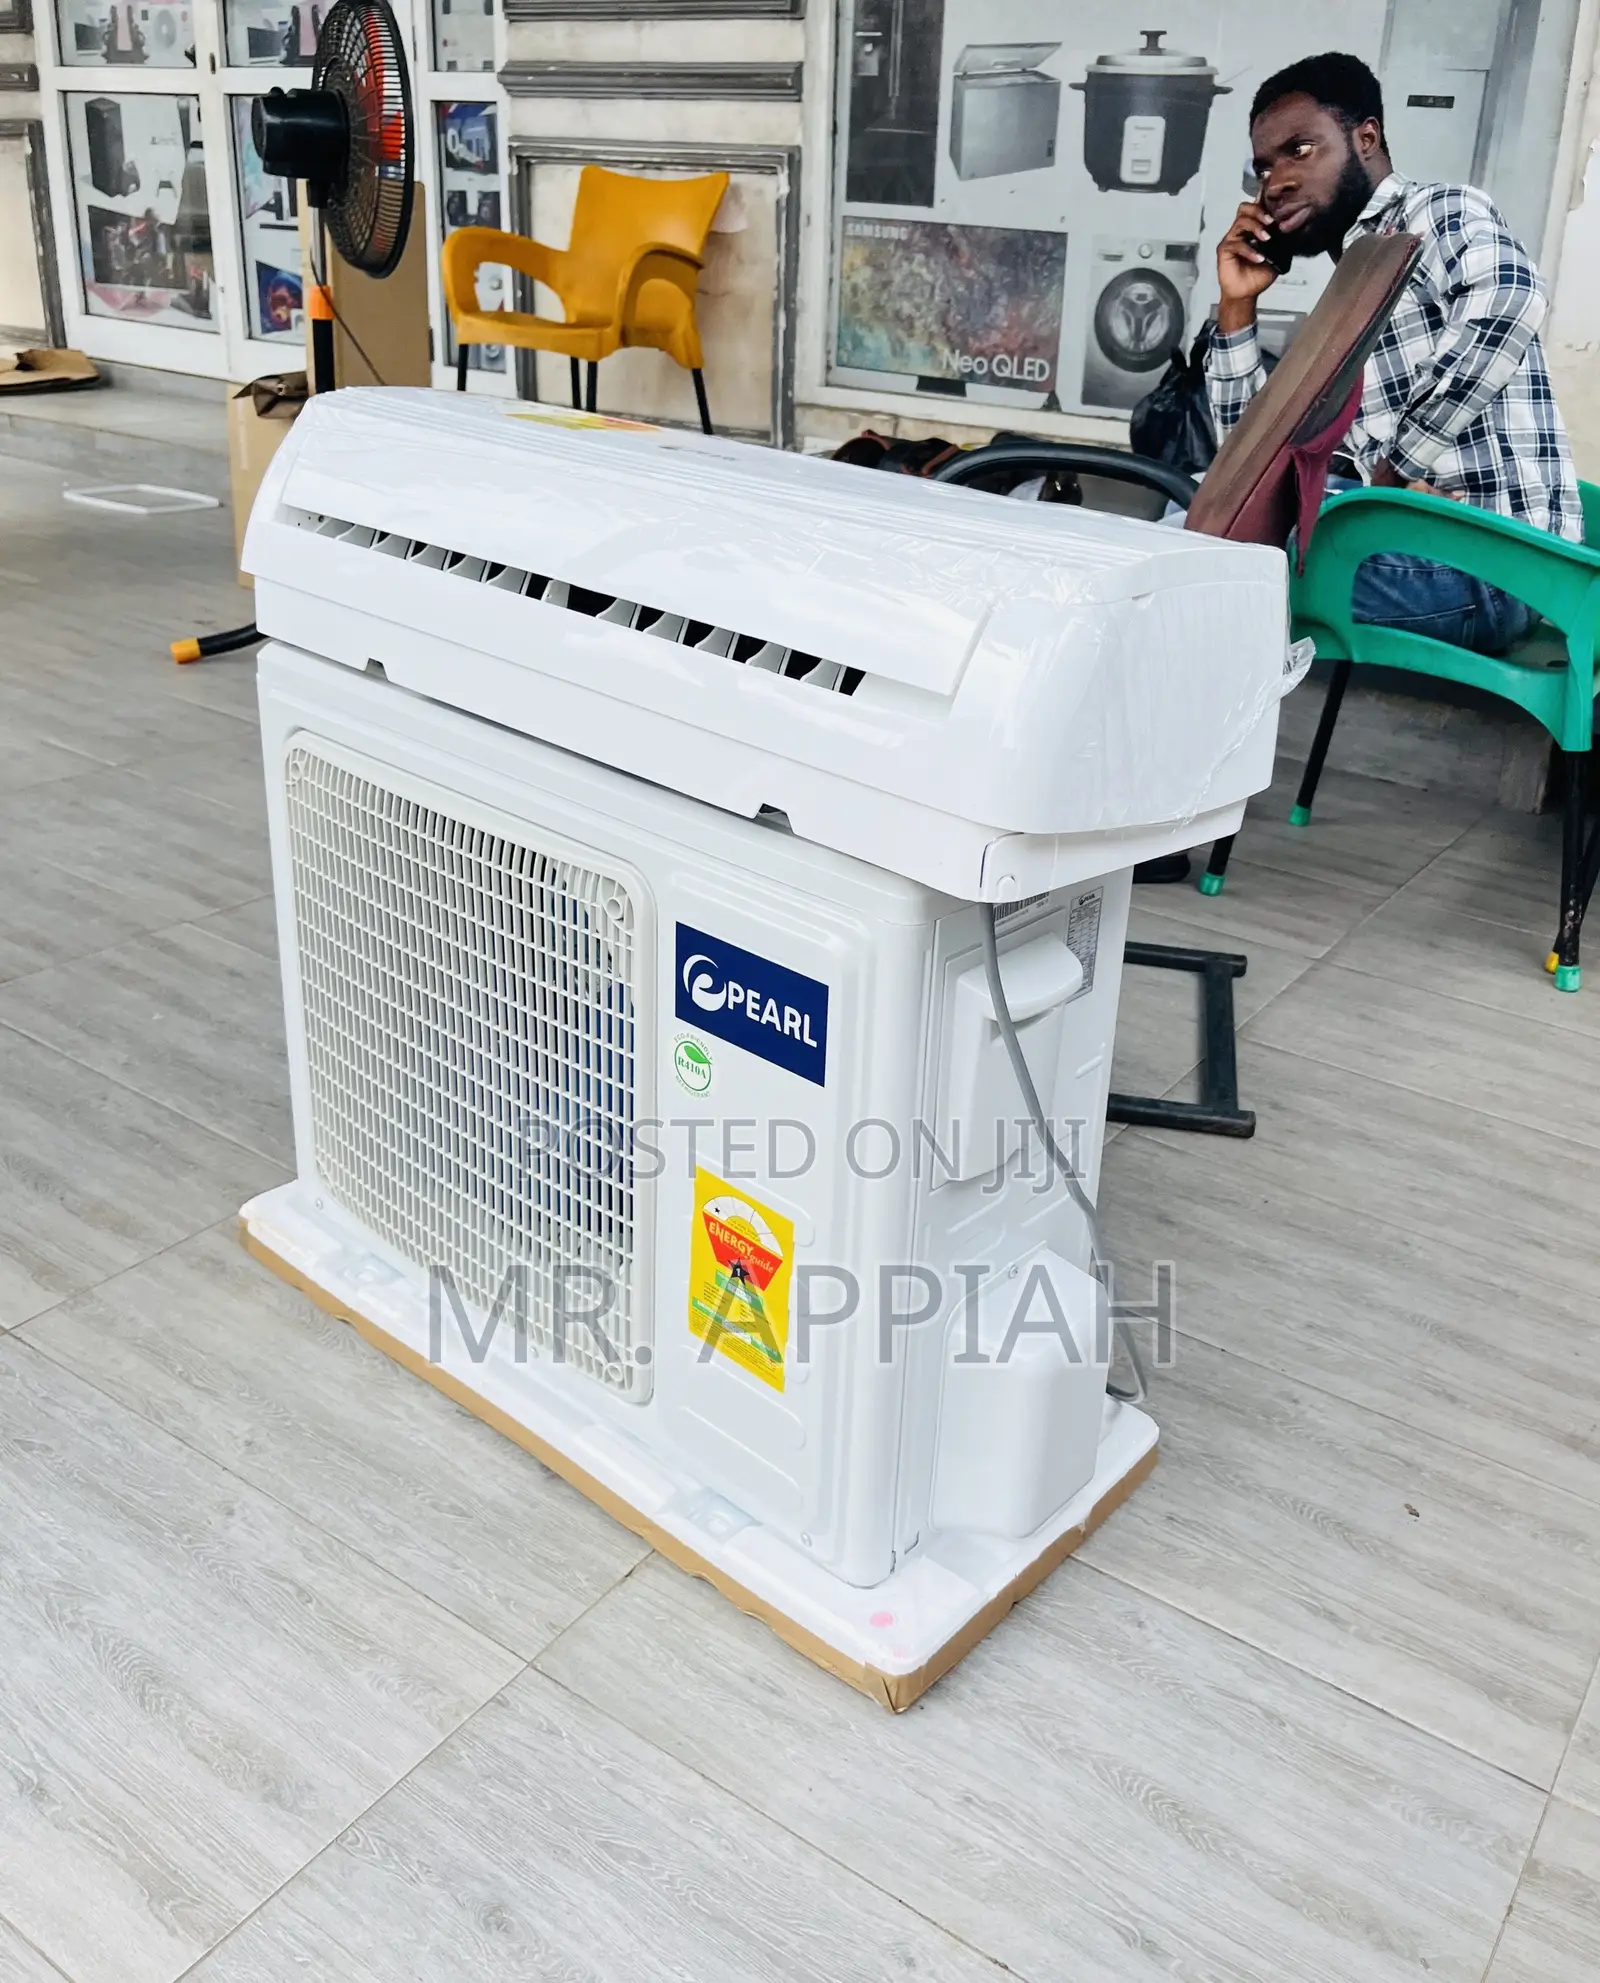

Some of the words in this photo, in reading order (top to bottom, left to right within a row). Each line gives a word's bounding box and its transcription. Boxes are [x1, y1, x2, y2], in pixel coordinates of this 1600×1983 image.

[941, 349, 988, 376] Neo
[992, 354, 1050, 382] QLED
[727, 980, 818, 1048] PEARL
[677, 1056, 707, 1079] R410A
[708, 1221, 754, 1255] ENERGY
[748, 1253, 775, 1273] guide
